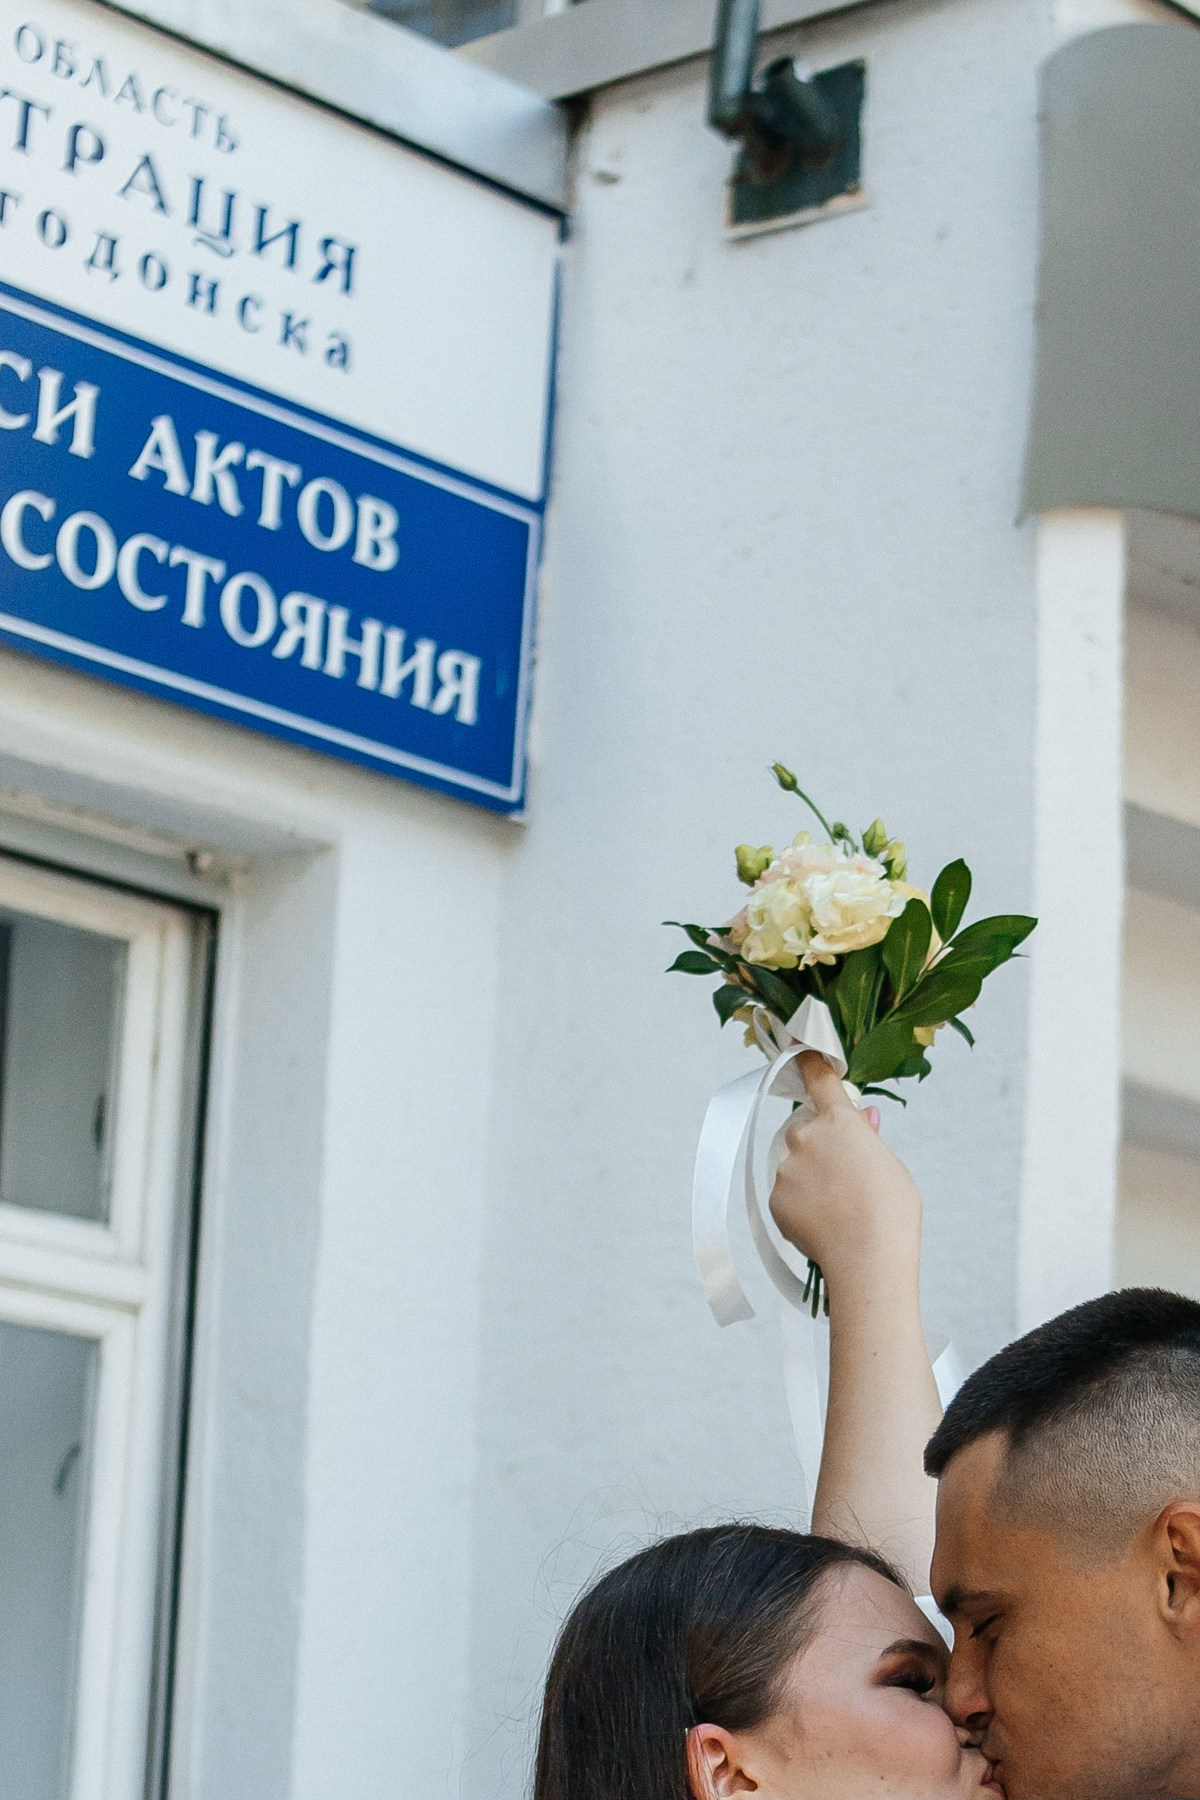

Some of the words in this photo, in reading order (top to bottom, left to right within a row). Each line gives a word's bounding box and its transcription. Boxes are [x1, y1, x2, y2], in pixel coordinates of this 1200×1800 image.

[0, 89, 361, 298] ТРАЦИЯ
[14, 23, 238, 154] ОБЛАСТЬ
[0, 348, 101, 460] СИ
[127, 414, 401, 573] АКТОВ
[0, 489, 483, 727] СОСТОЯНИЯ
